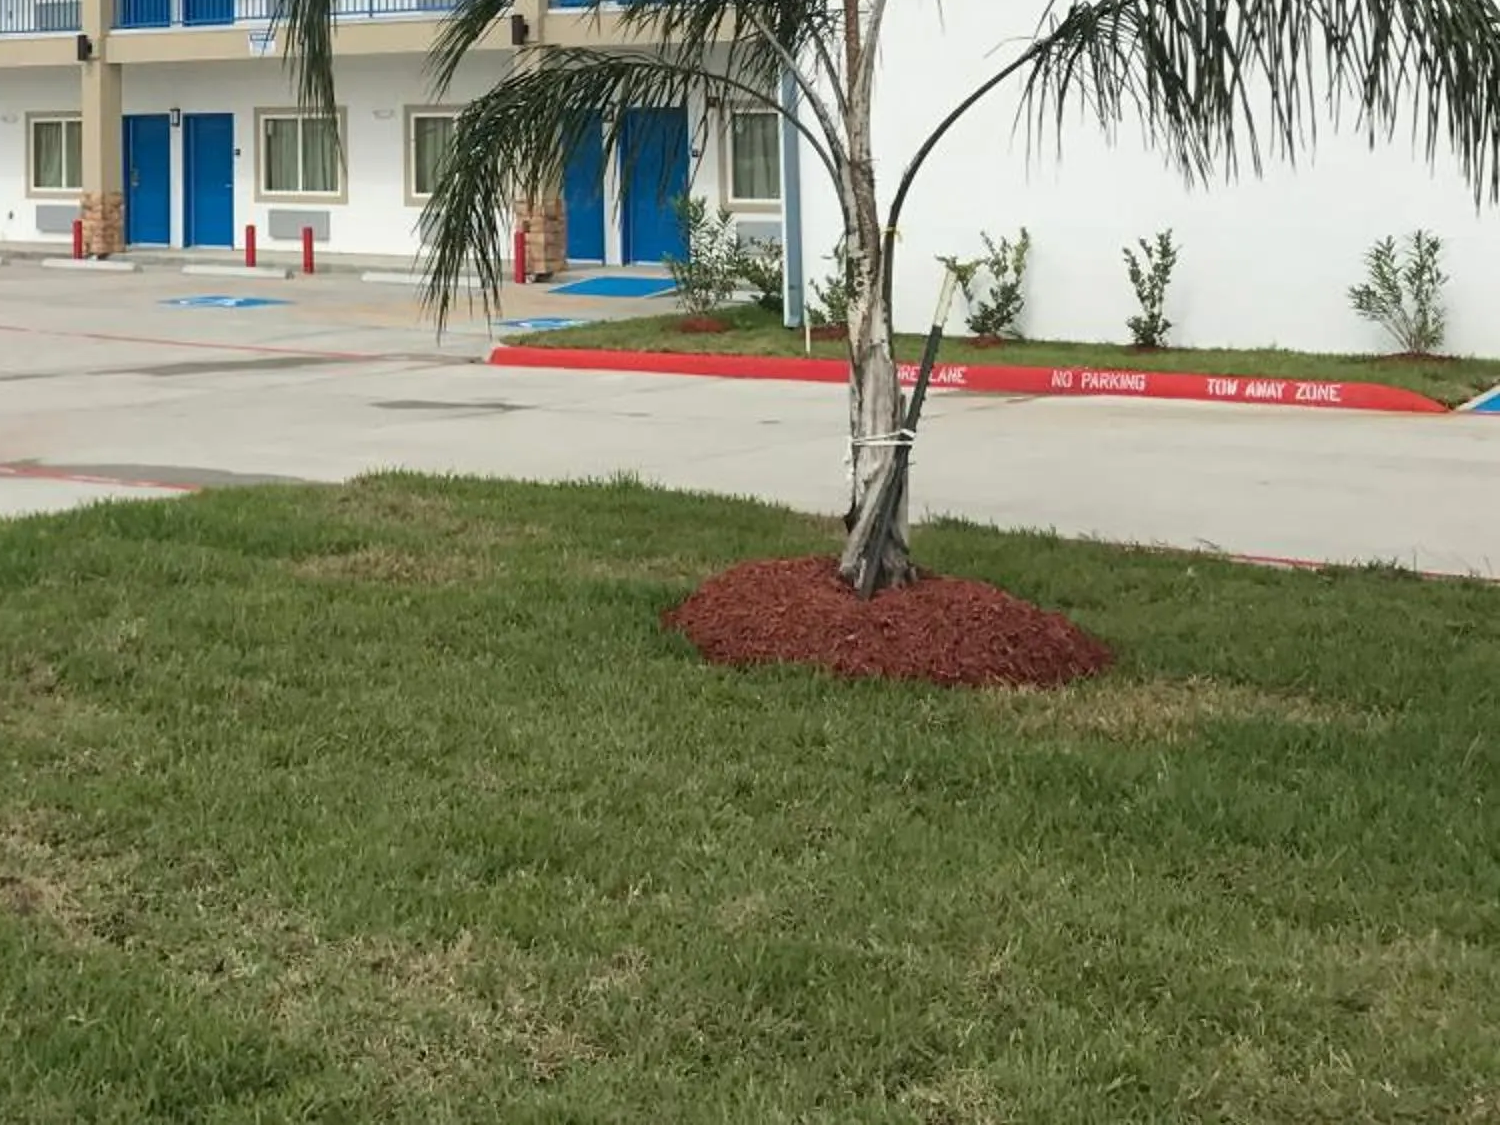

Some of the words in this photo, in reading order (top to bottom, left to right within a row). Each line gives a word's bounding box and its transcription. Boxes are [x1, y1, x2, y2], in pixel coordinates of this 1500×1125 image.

[896, 362, 921, 381] IRE
[928, 365, 967, 384] LANE
[1051, 369, 1073, 387] NO
[1081, 372, 1145, 391] PARKING
[1207, 378, 1238, 395] TOW
[1245, 380, 1286, 399] AWAY
[1295, 382, 1342, 402] ZONE
